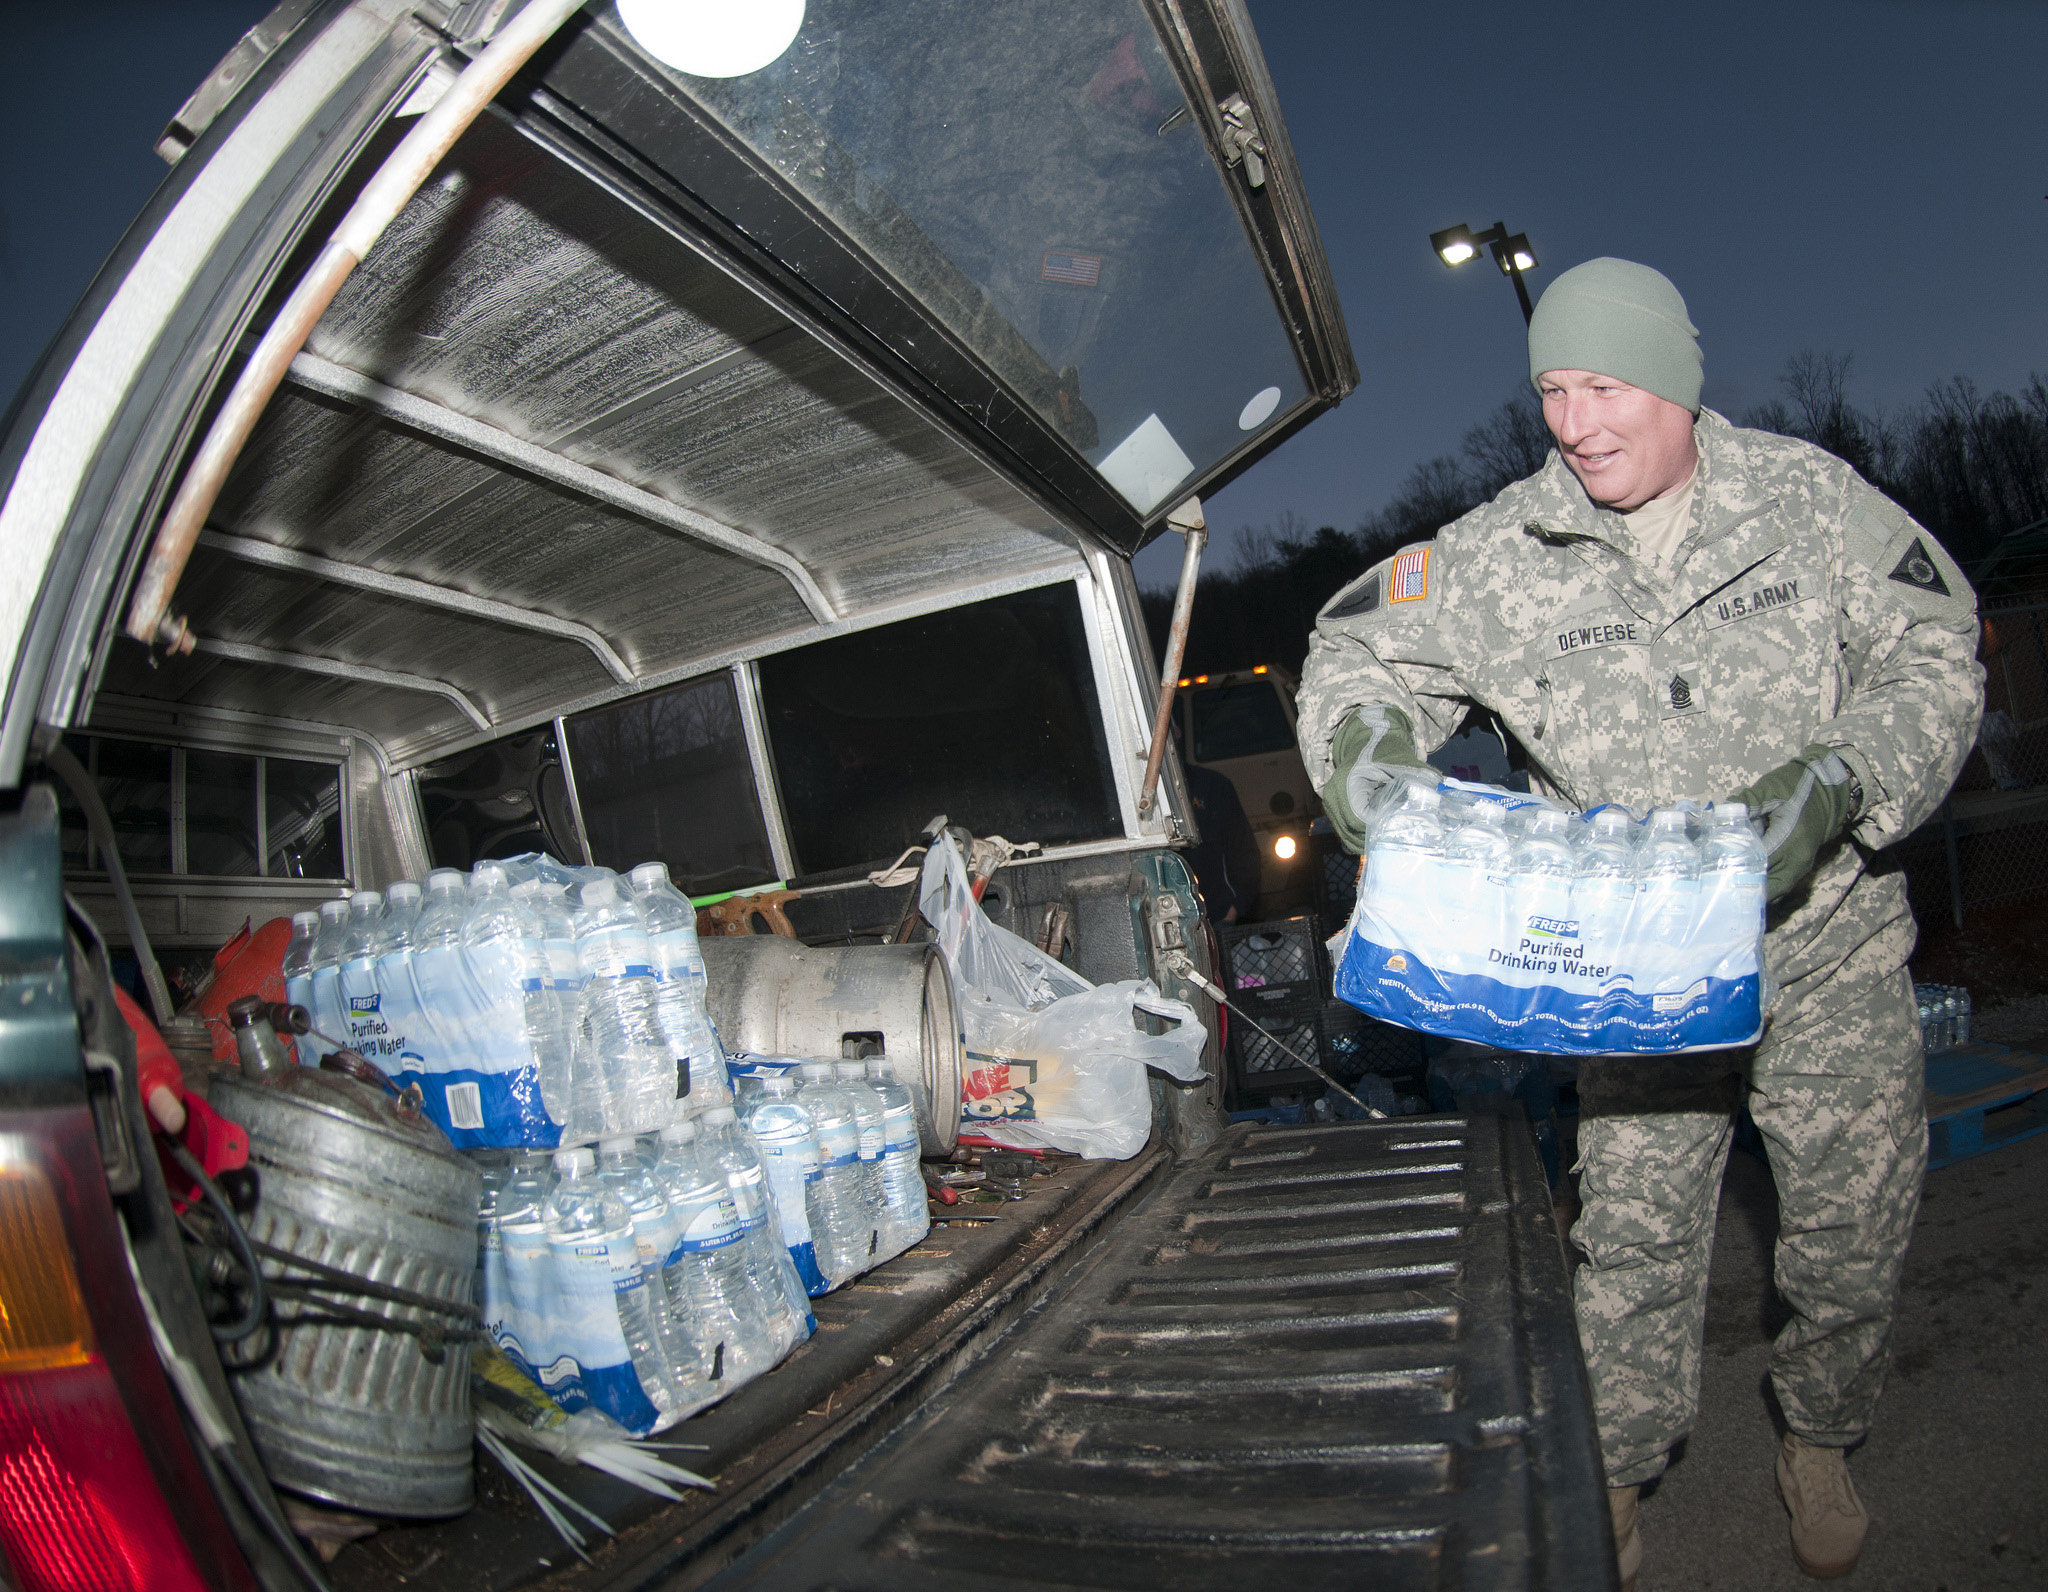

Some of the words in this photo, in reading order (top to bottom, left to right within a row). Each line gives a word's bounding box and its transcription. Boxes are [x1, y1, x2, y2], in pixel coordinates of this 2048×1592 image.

[1557, 623, 1638, 652] DEWEESE
[1519, 938, 1584, 959] Purified
[1488, 948, 1557, 974] Drinking
[1562, 959, 1612, 977] Water
[352, 994, 379, 1010] FRED'S
[1378, 977, 1406, 991] TWENTY
[1478, 1004, 1487, 1014] FL
[1497, 1016, 1529, 1028] BOTTLES
[1535, 1012, 1559, 1022] TOTAL
[1559, 1017, 1588, 1031] VOLUME
[1603, 1016, 1628, 1027] LITERS
[352, 1020, 388, 1038] Purified
[378, 1036, 406, 1056] Water
[577, 1245, 606, 1256] FRED'S
